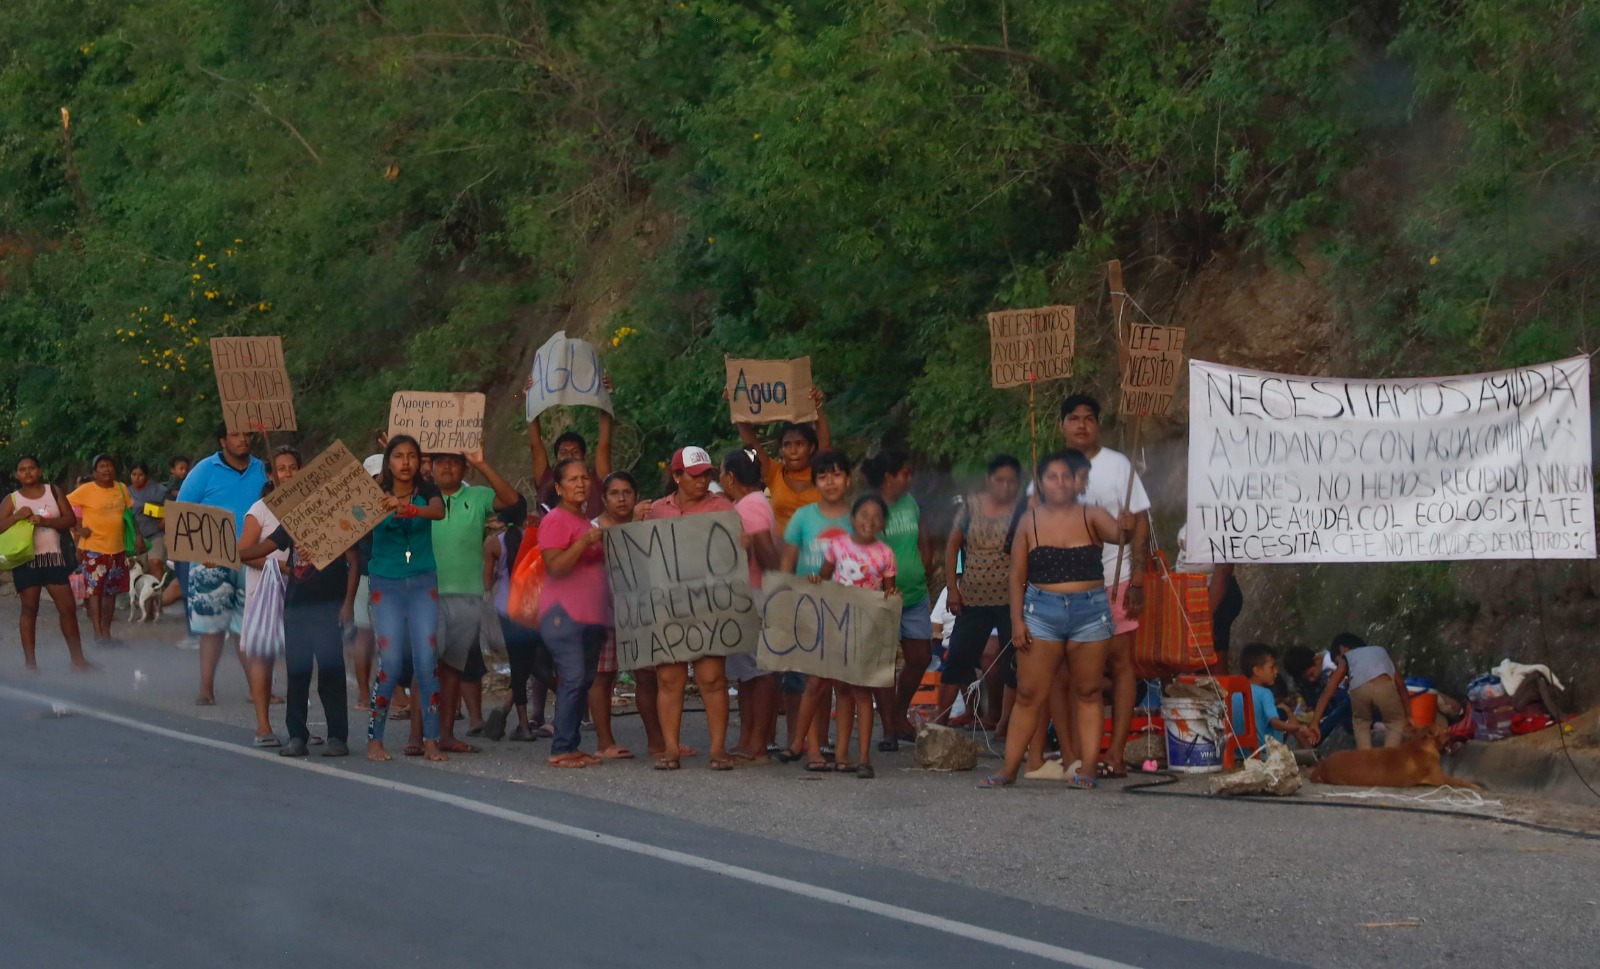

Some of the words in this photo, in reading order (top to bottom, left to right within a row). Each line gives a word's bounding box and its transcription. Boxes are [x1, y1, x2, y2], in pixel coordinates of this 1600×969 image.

[215, 339, 278, 370] AYUDA
[993, 338, 1036, 362] AYUDA
[1038, 334, 1052, 358] EN
[1055, 332, 1072, 355] LA
[1166, 328, 1184, 351] TE
[221, 370, 284, 401] COMIDA
[733, 367, 787, 414] Agua
[1477, 365, 1577, 414] AYUDA
[226, 402, 240, 430] Y
[397, 395, 455, 414] Apoyenos
[420, 415, 429, 428] lo
[434, 419, 453, 434] que
[420, 430, 446, 449] POR
[1360, 428, 1415, 464] CON
[1317, 472, 1351, 502] NO
[1361, 469, 1436, 500] HEMOS
[1441, 463, 1528, 500] RECIBIDO
[1196, 503, 1247, 533] TIPO
[1256, 503, 1283, 532] DE
[1358, 504, 1403, 531] COL
[173, 511, 237, 563] APOYO
[1332, 532, 1376, 557] CFE
[1383, 531, 1404, 557] NO
[1405, 531, 1427, 556] TE
[1491, 532, 1508, 553] DE
[606, 521, 738, 593] AMLO
[619, 638, 639, 664] TU
[651, 618, 742, 663] APOYO
